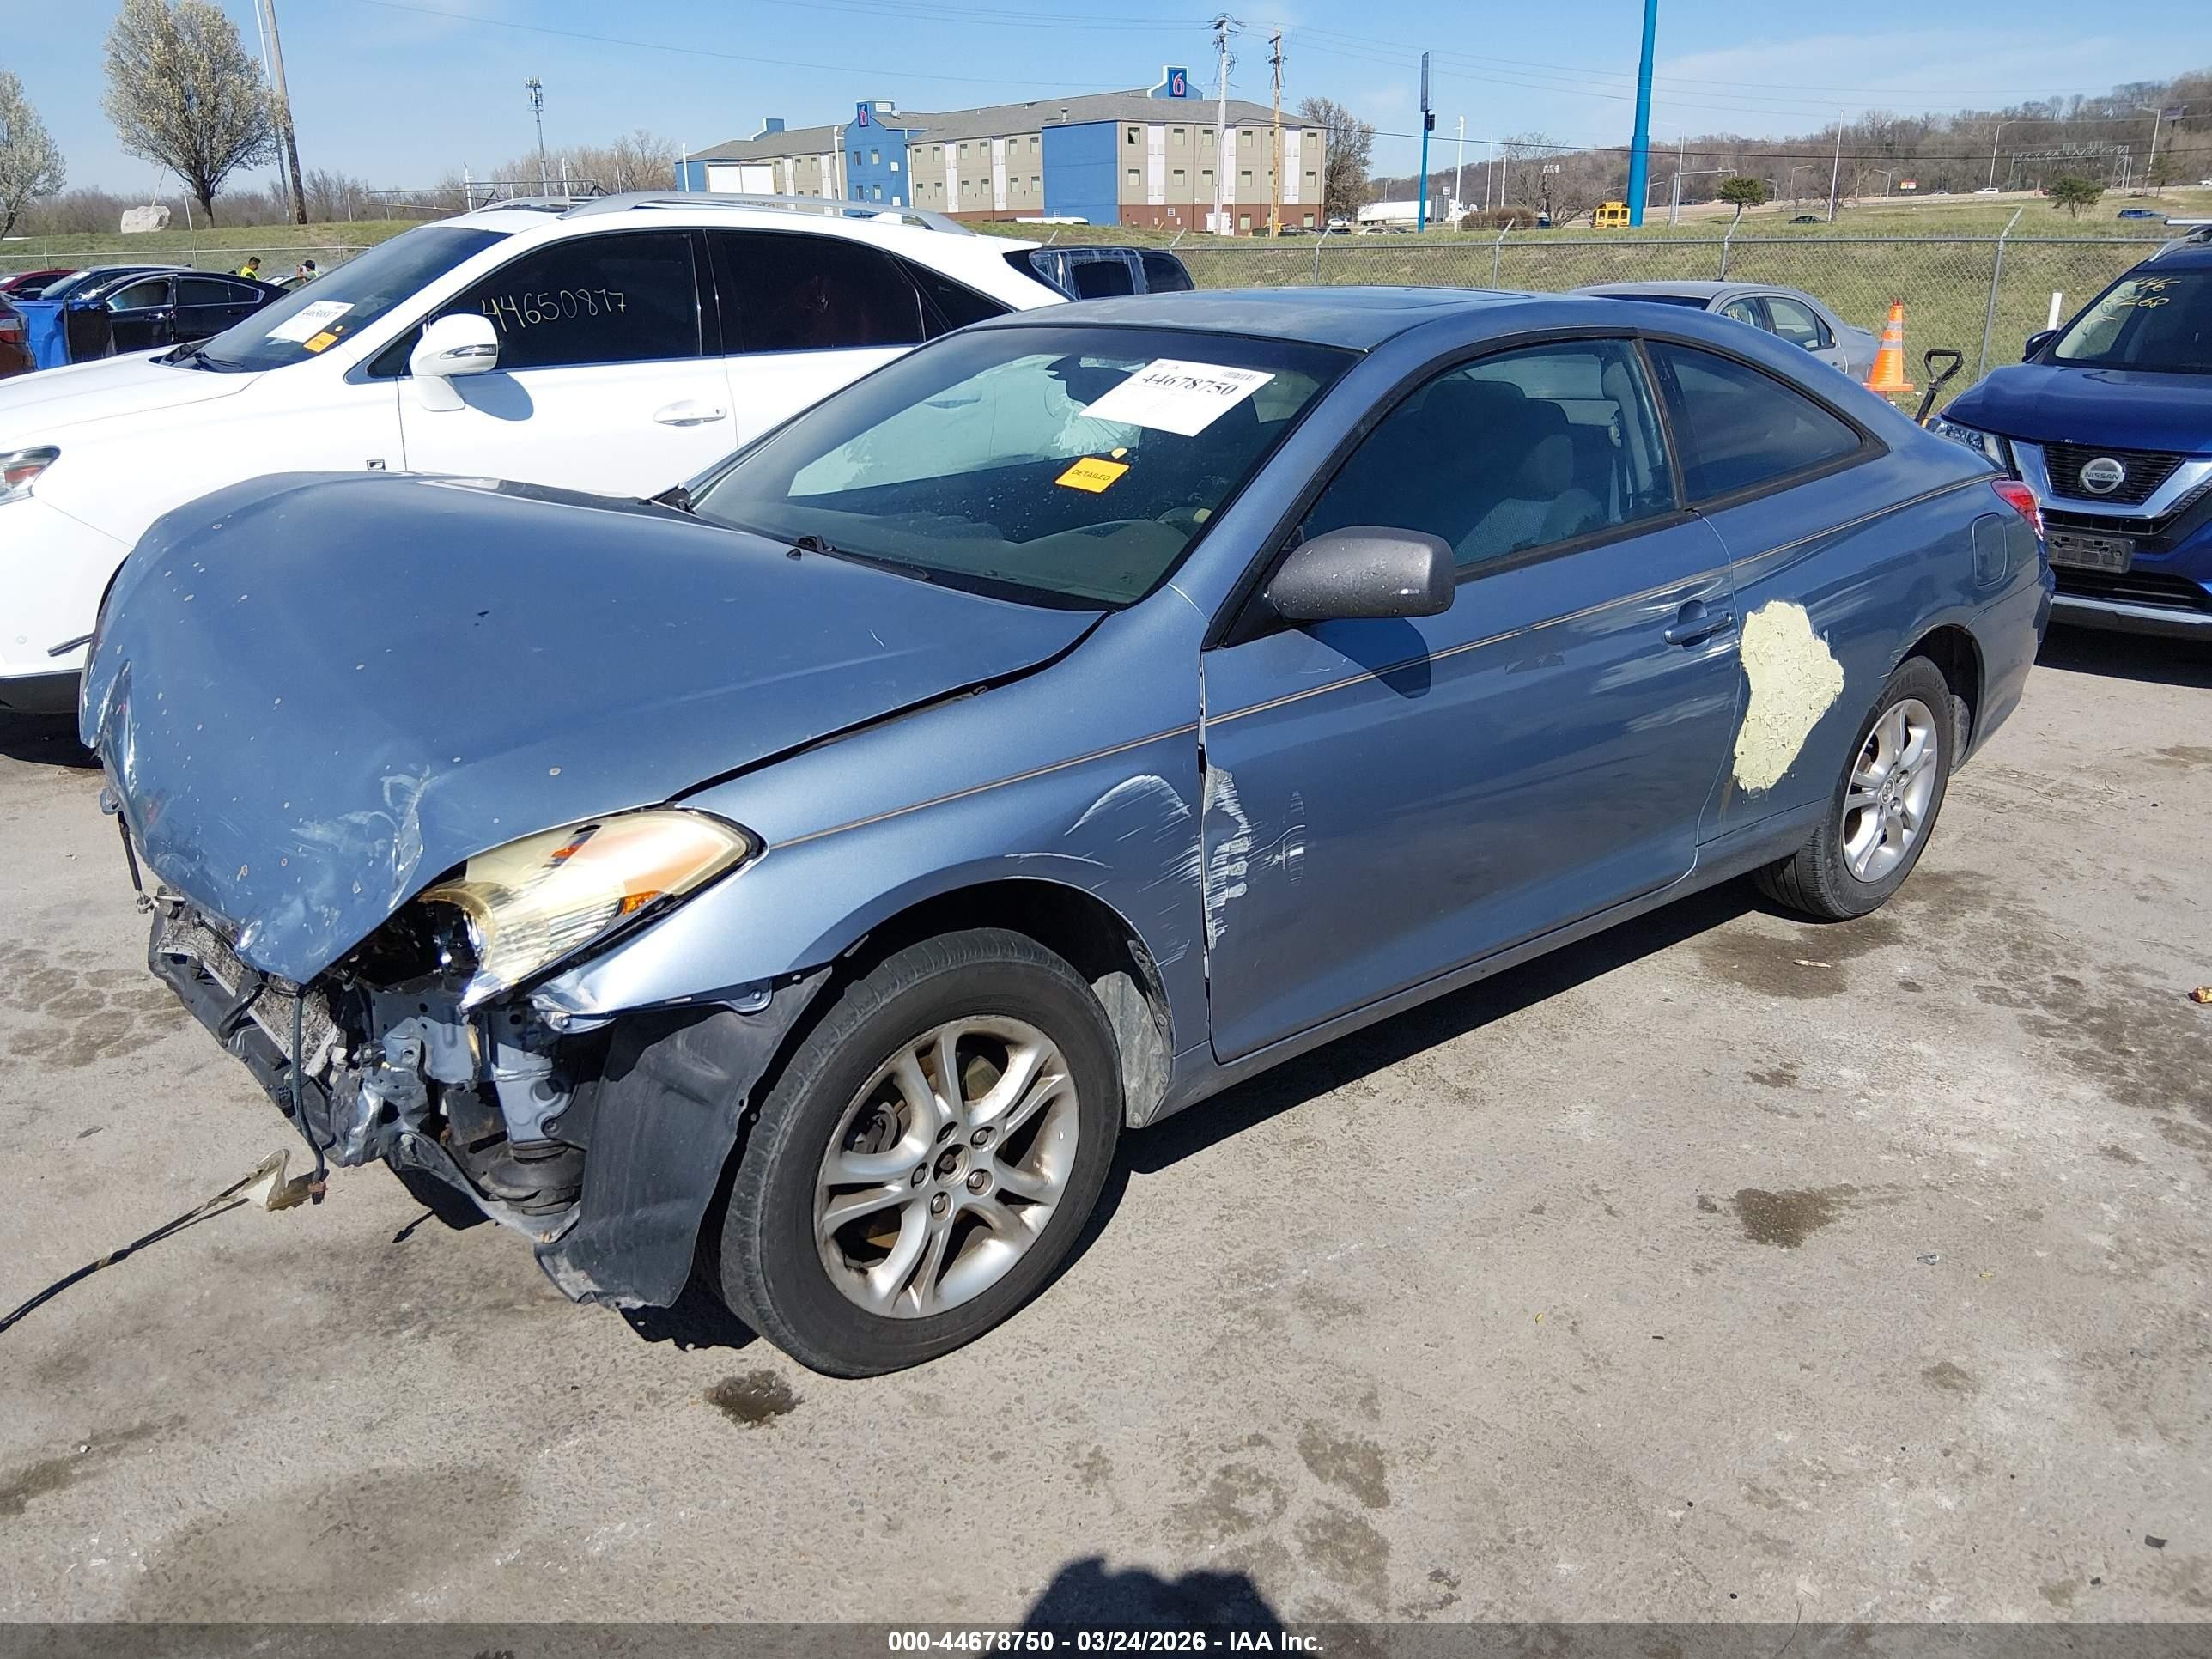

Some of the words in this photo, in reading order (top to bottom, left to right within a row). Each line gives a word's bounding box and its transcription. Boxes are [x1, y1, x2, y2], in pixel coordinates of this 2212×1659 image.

[1173, 72, 1185, 96] 6
[1142, 373, 1238, 395] 44678750
[1072, 469, 1111, 481] DETAILED
[2086, 471, 2119, 480] NISSAN
